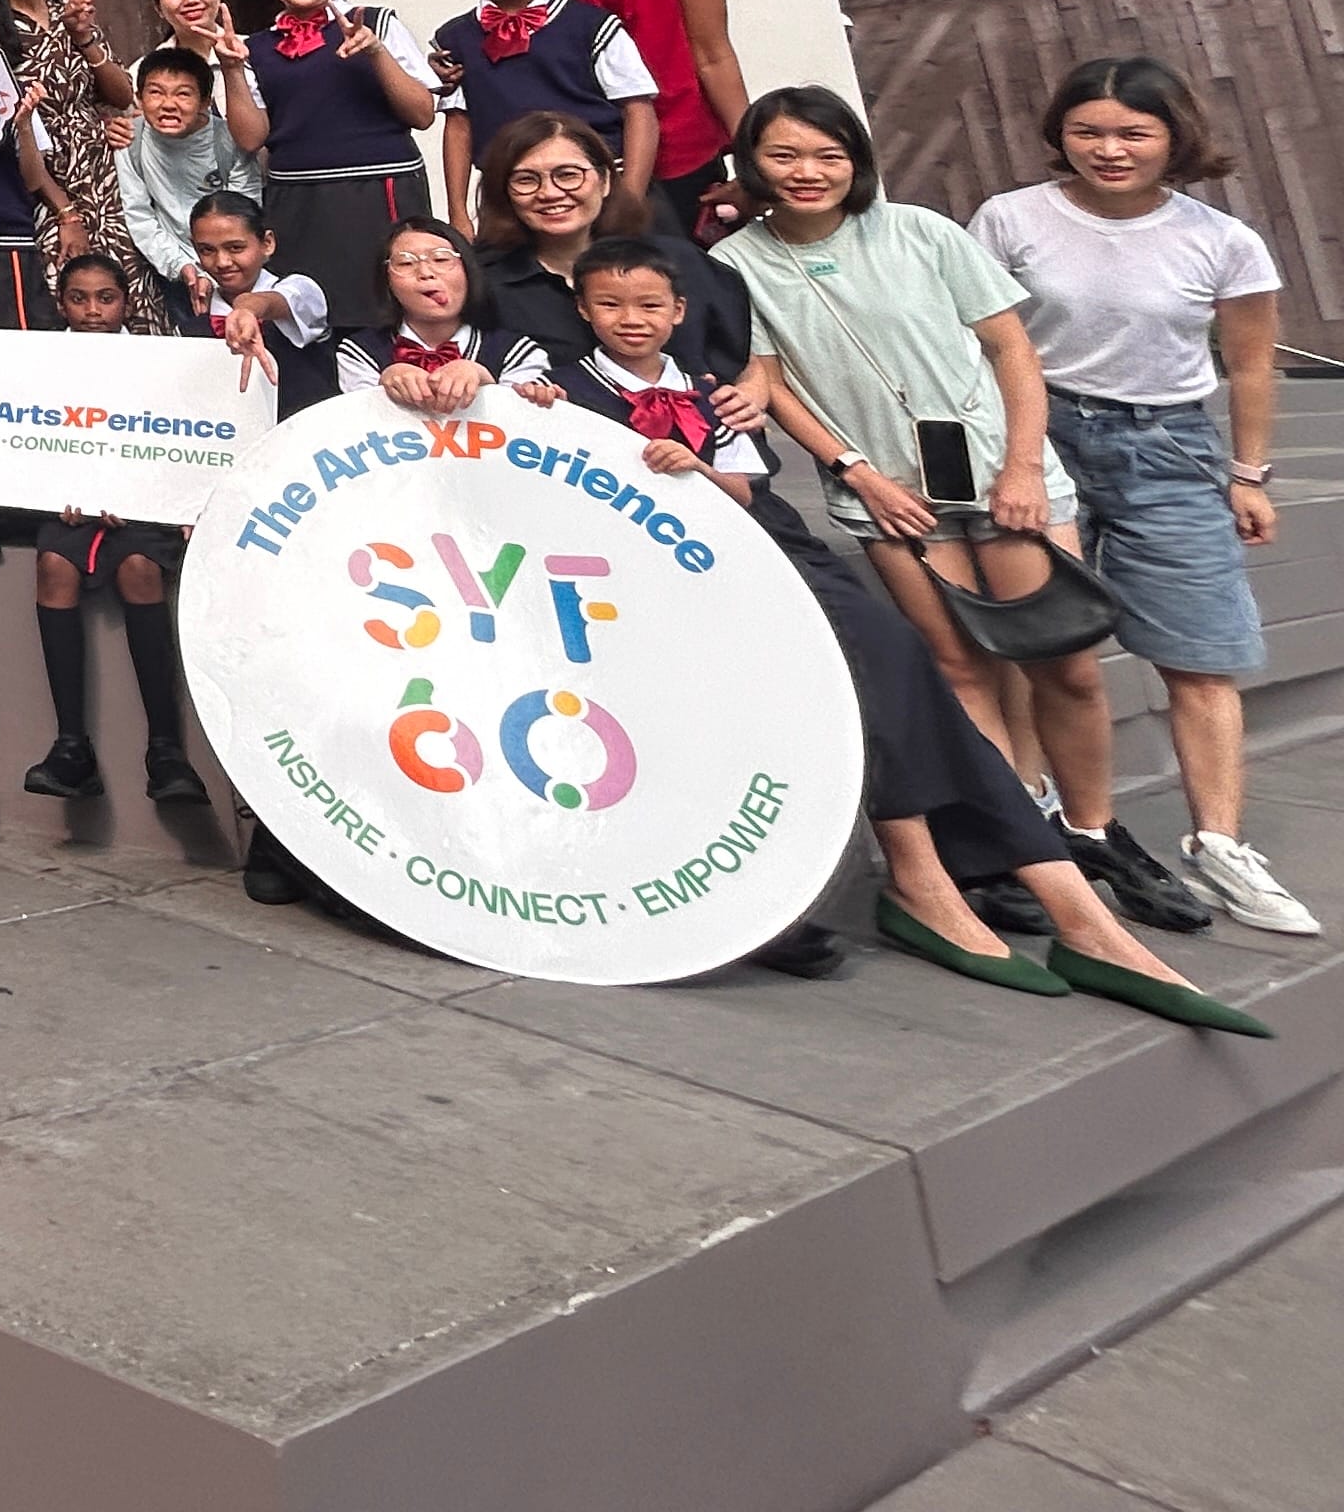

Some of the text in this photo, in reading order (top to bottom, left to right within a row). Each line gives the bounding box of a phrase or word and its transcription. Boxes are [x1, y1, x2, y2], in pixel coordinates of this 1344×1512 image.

[9, 435, 110, 458] CONNECT
[120, 445, 235, 469] EMPOWER
[236, 419, 715, 574] The ArtsXPerience
[347, 533, 619, 664] SYF
[389, 677, 637, 811] 60
[263, 729, 790, 926] INSPIRE CONNECT EMPOWER
